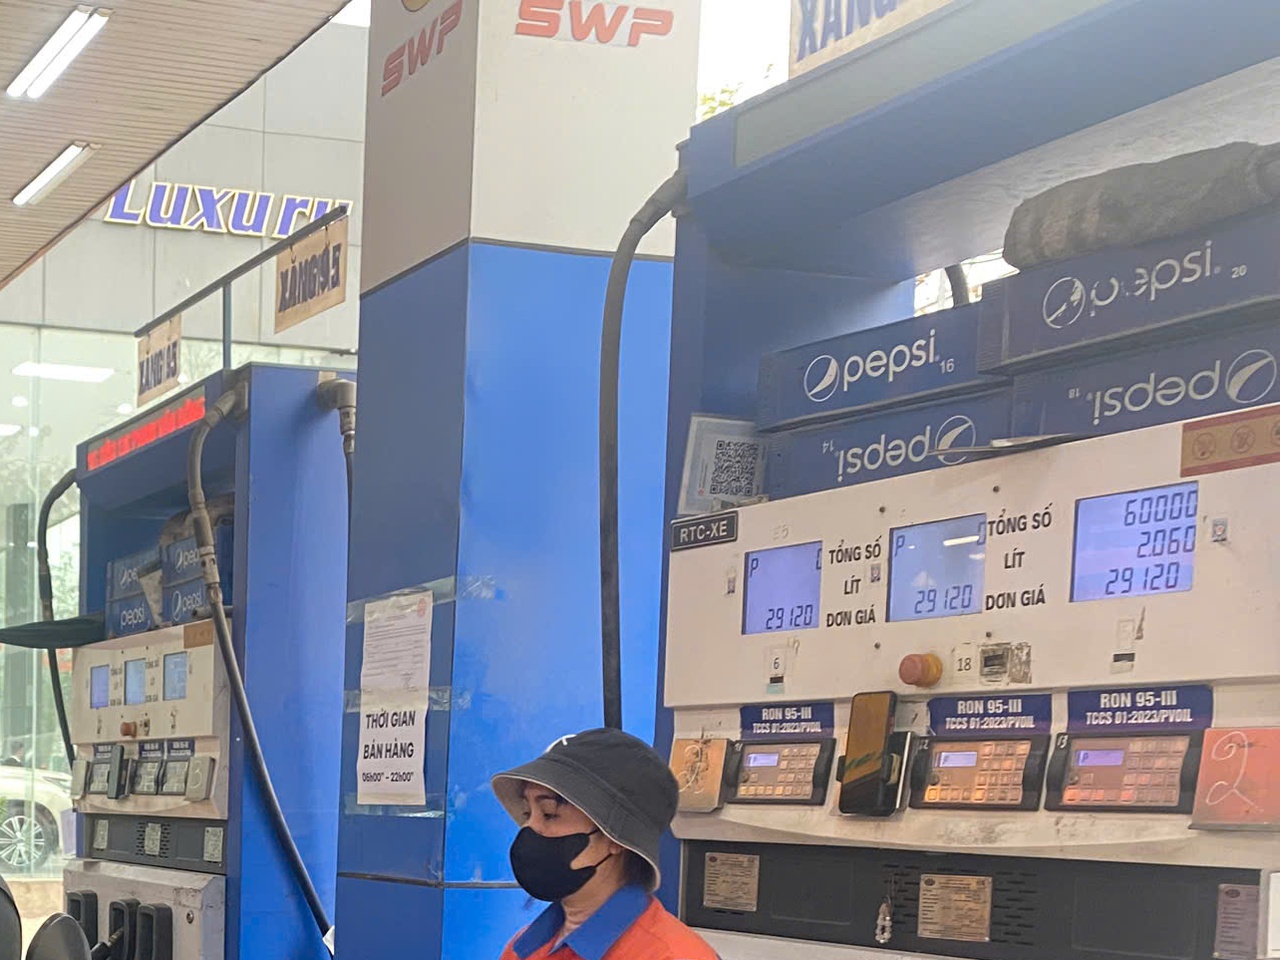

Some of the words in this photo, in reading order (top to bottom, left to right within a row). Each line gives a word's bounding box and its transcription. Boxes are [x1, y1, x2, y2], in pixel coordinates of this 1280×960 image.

[515, 0, 674, 47] SWP
[381, 1, 463, 97] SWP
[1231, 263, 1248, 278] 20
[842, 329, 937, 393] pepsi
[939, 358, 956, 374] 16
[1068, 388, 1082, 400] 18
[1092, 360, 1222, 426] pepsi
[822, 439, 835, 454] 14
[837, 424, 932, 483] pepsi
[988, 509, 1028, 537] TỔNG
[1032, 502, 1054, 529] SỐ
[1124, 489, 1199, 527] 60000
[679, 520, 728, 543] RTC-XE
[1136, 524, 1197, 559] 2.060
[828, 540, 861, 565] TỔNG
[865, 535, 883, 560] SỐ
[1003, 547, 1026, 571] LÍT
[843, 574, 862, 596] LÍT
[1105, 561, 1180, 596] 29120
[914, 584, 973, 614] 29120
[1020, 583, 1046, 607] GIÁ
[766, 604, 814, 630] 29120
[855, 603, 876, 625] GIÁ
[773, 657, 781, 670] 6
[957, 657, 972, 672] 18
[957, 700, 984, 714] RON
[986, 698, 1022, 714] 95-III
[1099, 692, 1132, 709] RON
[1135, 689, 1178, 708] 95-III
[365, 707, 389, 729] THỜI
[391, 710, 416, 728] GIAN
[762, 708, 782, 721] RON
[784, 706, 812, 720] 95-III
[945, 717, 968, 730] TCCS
[1085, 711, 1113, 726] TCCS
[363, 739, 383, 760] BÁN
[384, 737, 415, 759] HÀNG
